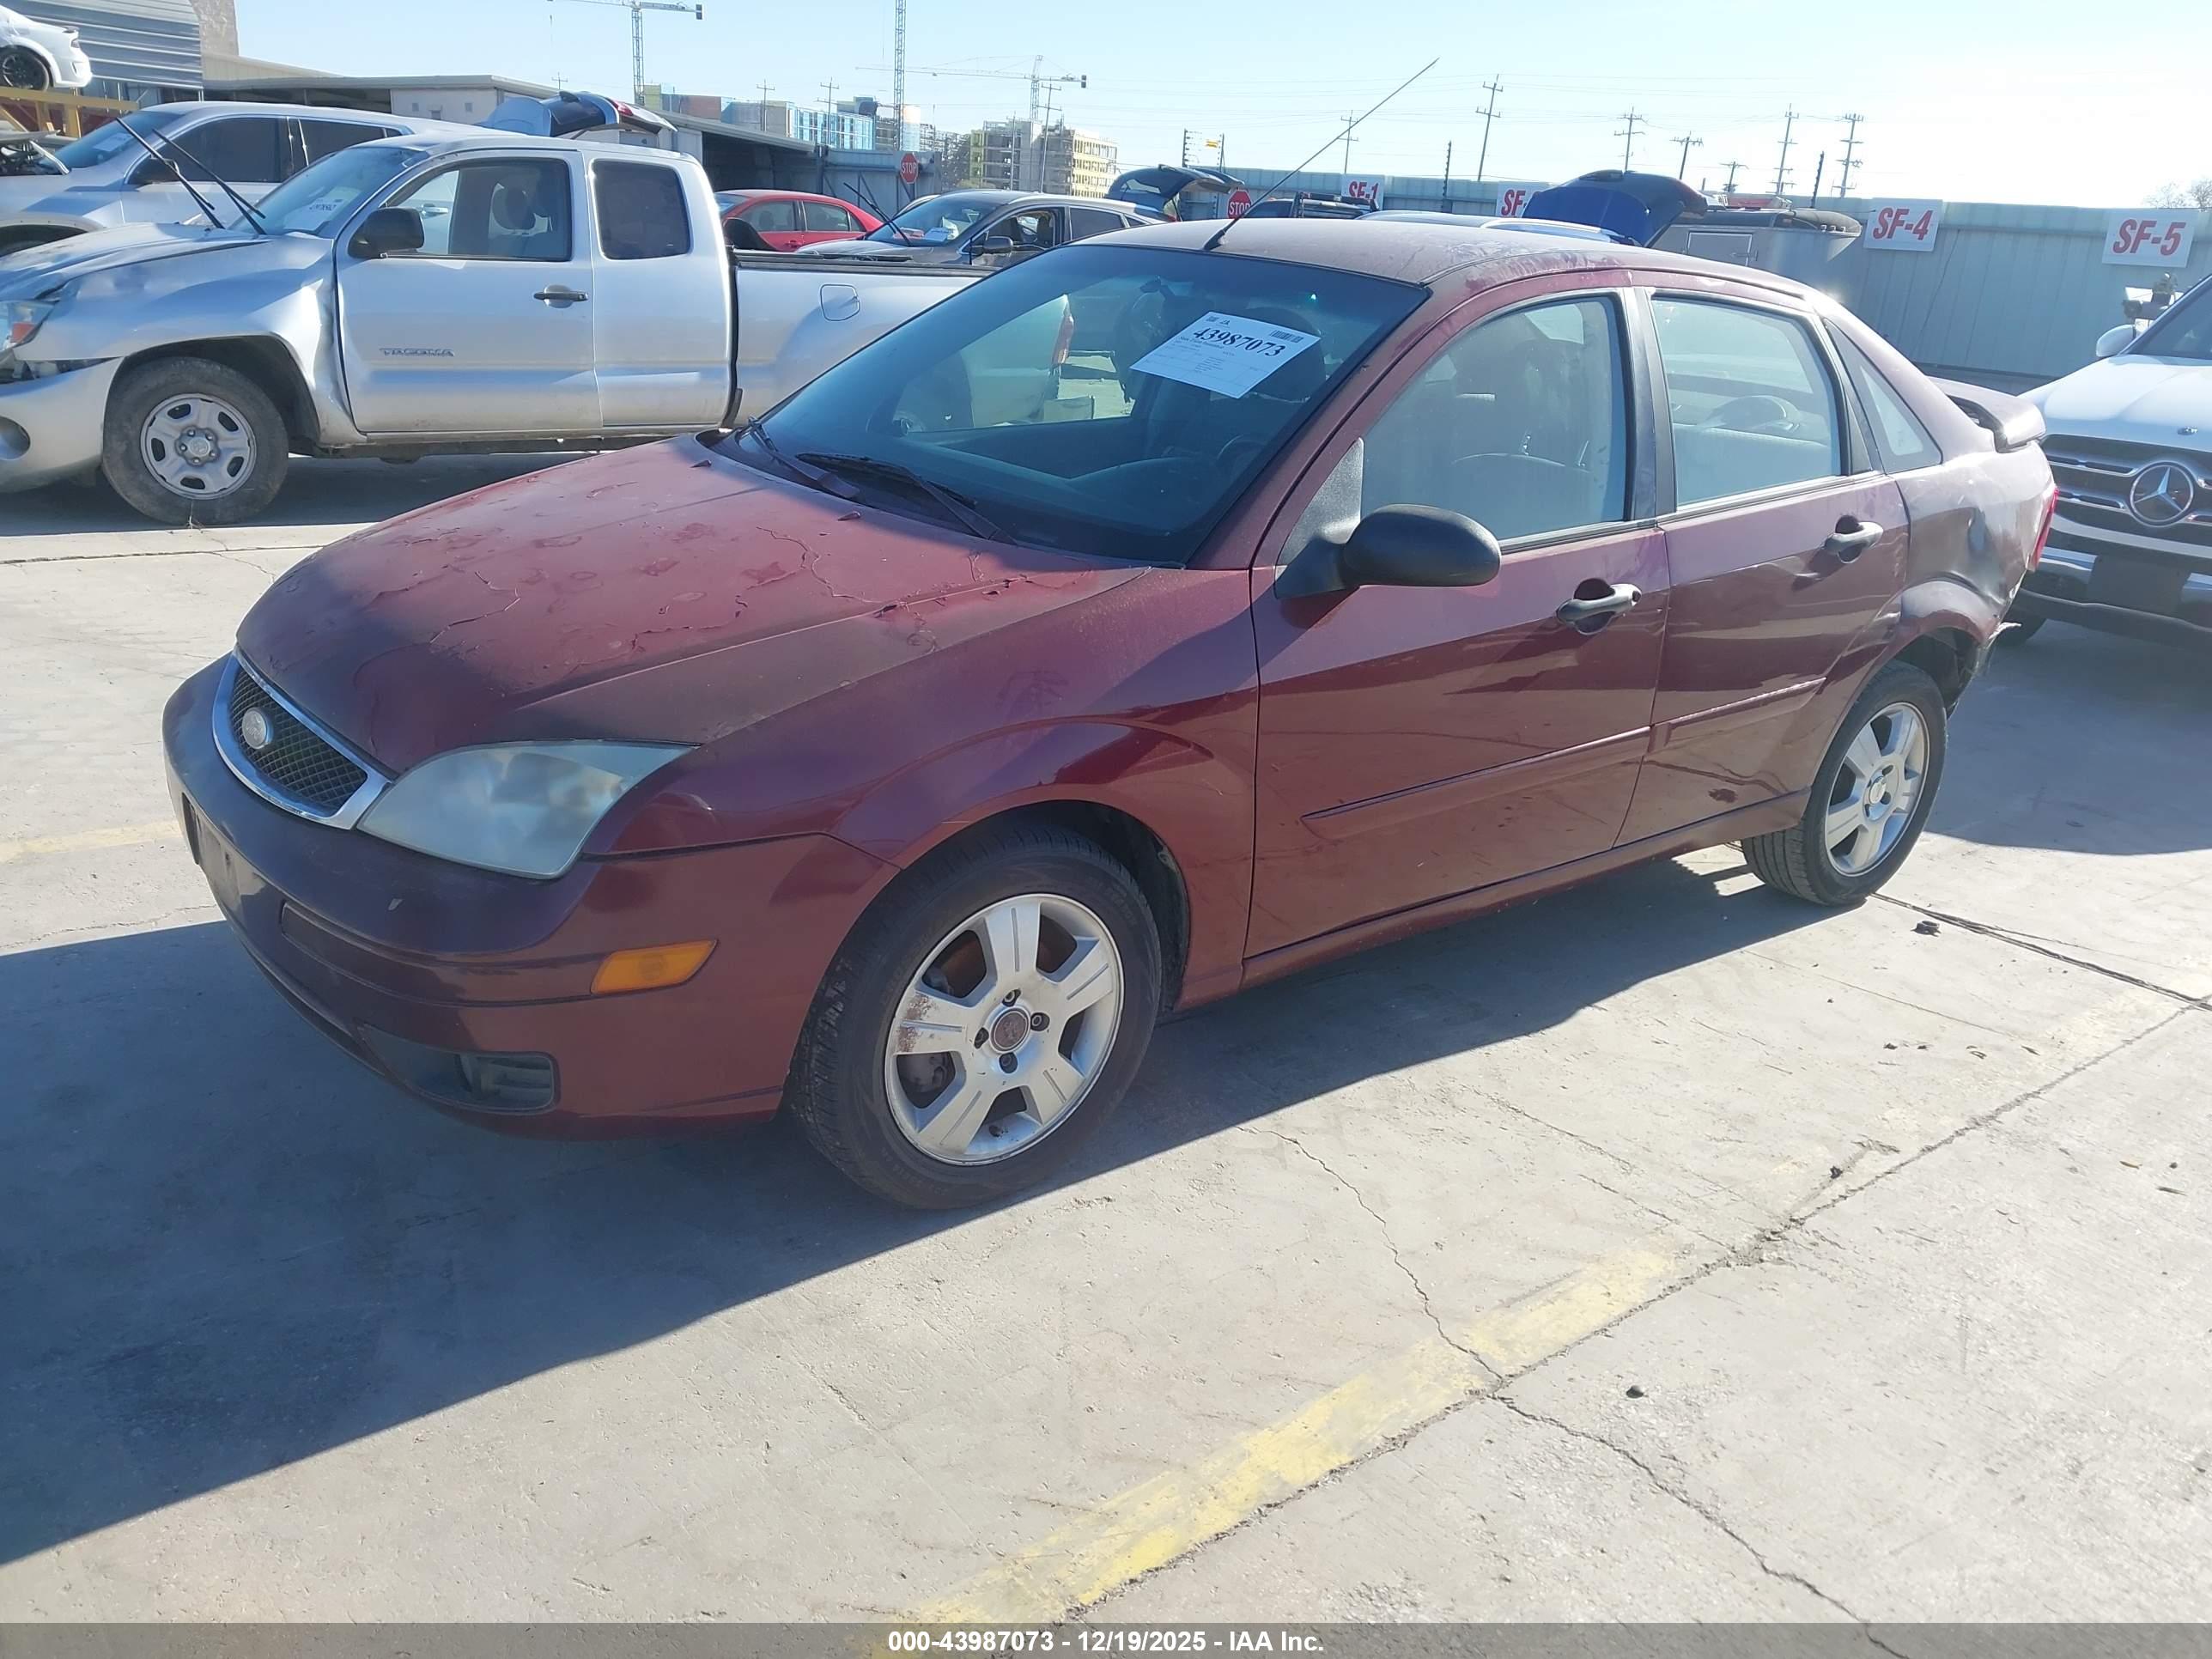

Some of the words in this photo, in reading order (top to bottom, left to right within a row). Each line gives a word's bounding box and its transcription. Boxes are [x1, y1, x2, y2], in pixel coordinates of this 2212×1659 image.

[902, 162, 917, 173] STOP
[1349, 181, 1379, 199] SF-1
[1873, 207, 1934, 240] SF-4
[2112, 218, 2187, 256] SF-5
[379, 348, 454, 357] TACOMA
[1193, 327, 1286, 357] 43987073
